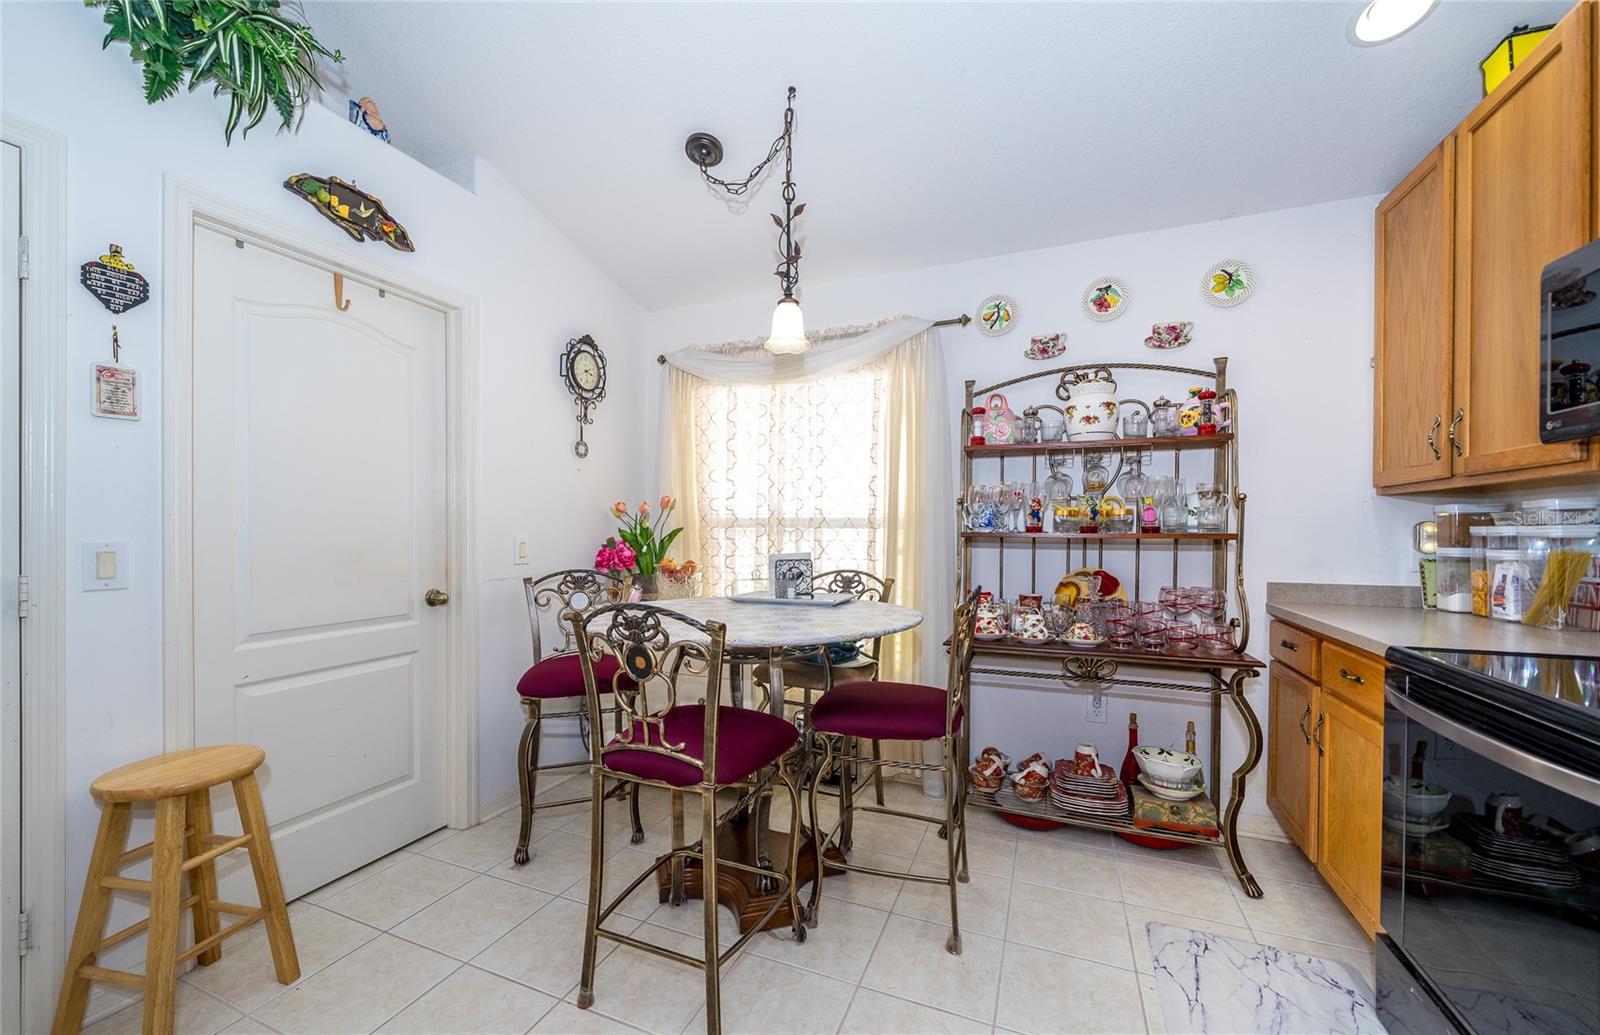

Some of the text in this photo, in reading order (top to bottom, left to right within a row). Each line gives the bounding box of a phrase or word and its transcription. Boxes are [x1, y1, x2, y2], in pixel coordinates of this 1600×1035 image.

[86, 266, 101, 274] THIS
[106, 271, 127, 280] HOUSE
[86, 273, 105, 281] LORD
[126, 283, 143, 291] PRAY
[86, 279, 106, 288] MAKE
[127, 289, 144, 298] SAFE
[115, 293, 134, 302] NIGHT
